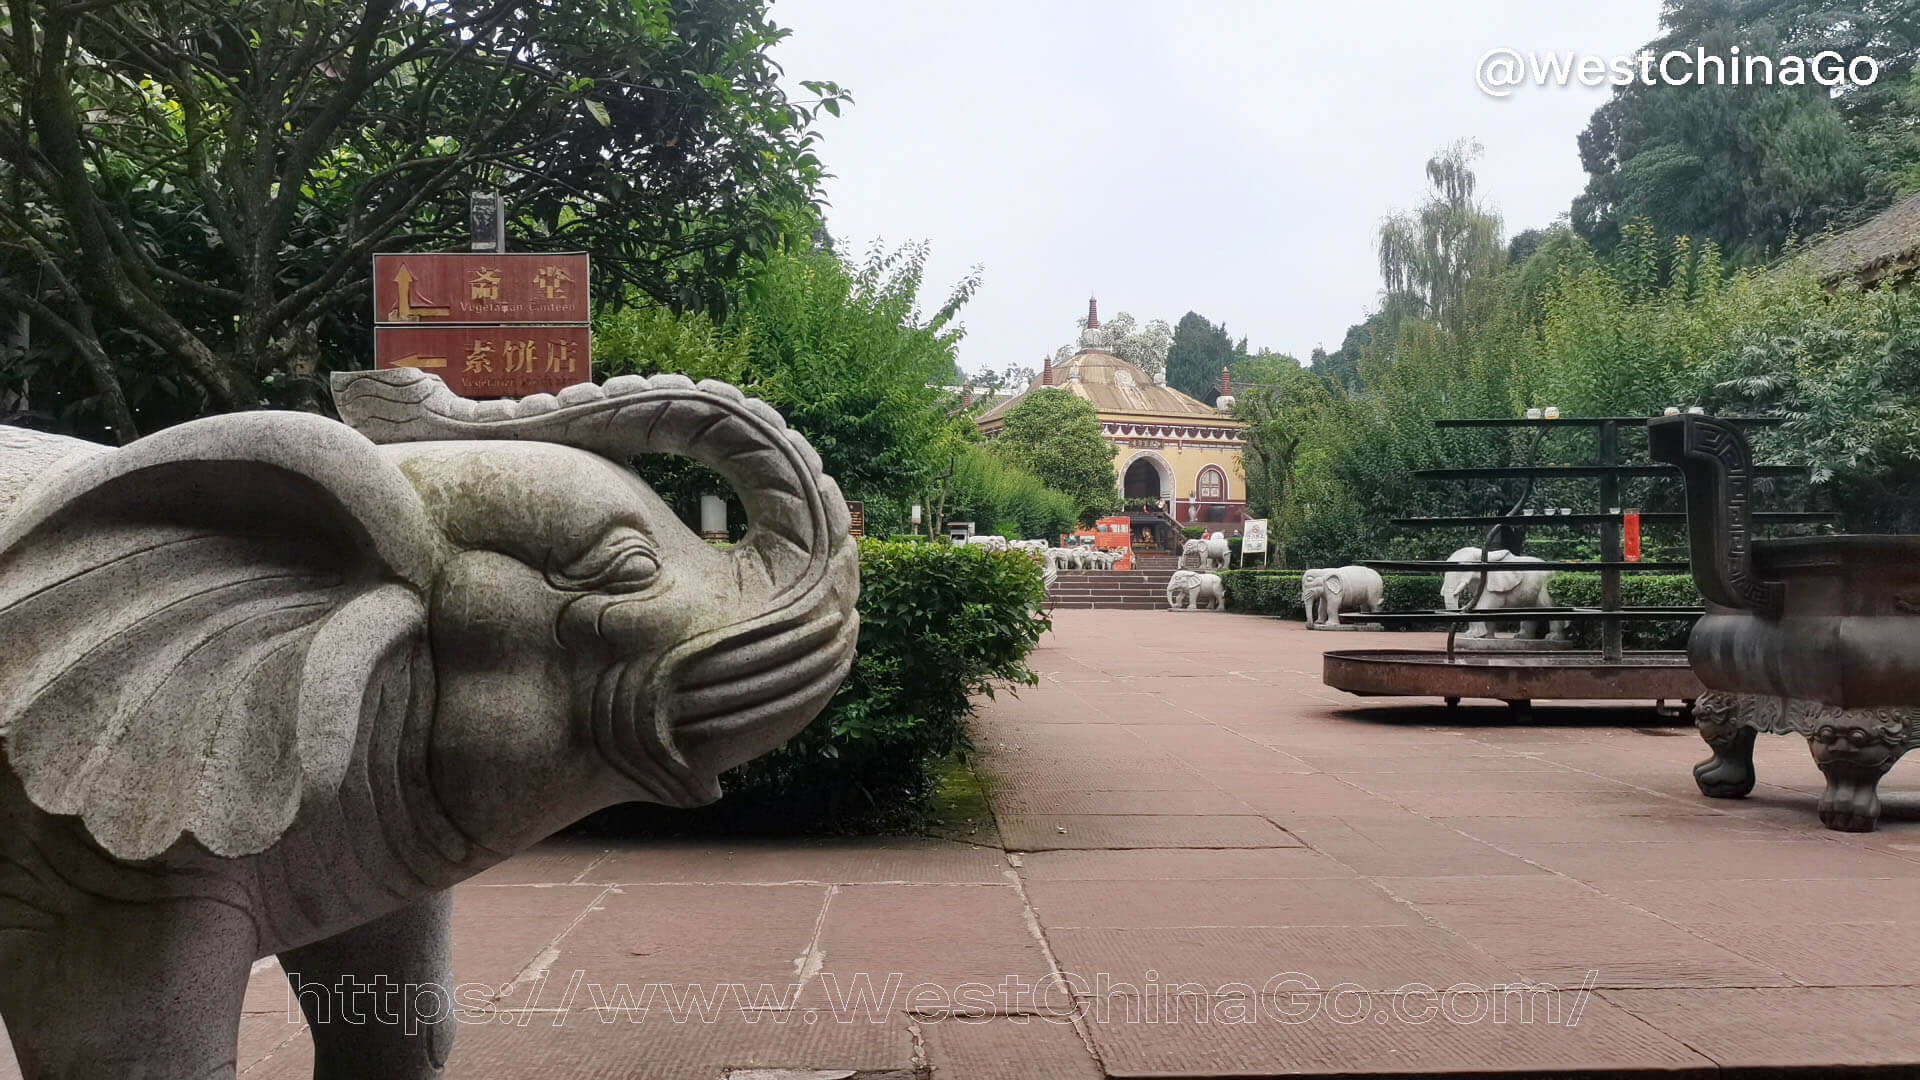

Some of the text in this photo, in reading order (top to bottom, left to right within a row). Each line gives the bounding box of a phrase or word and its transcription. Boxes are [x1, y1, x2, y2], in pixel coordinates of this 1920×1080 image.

[460, 302, 523, 314] Vegetaan
[463, 340, 577, 374] 素饼店
